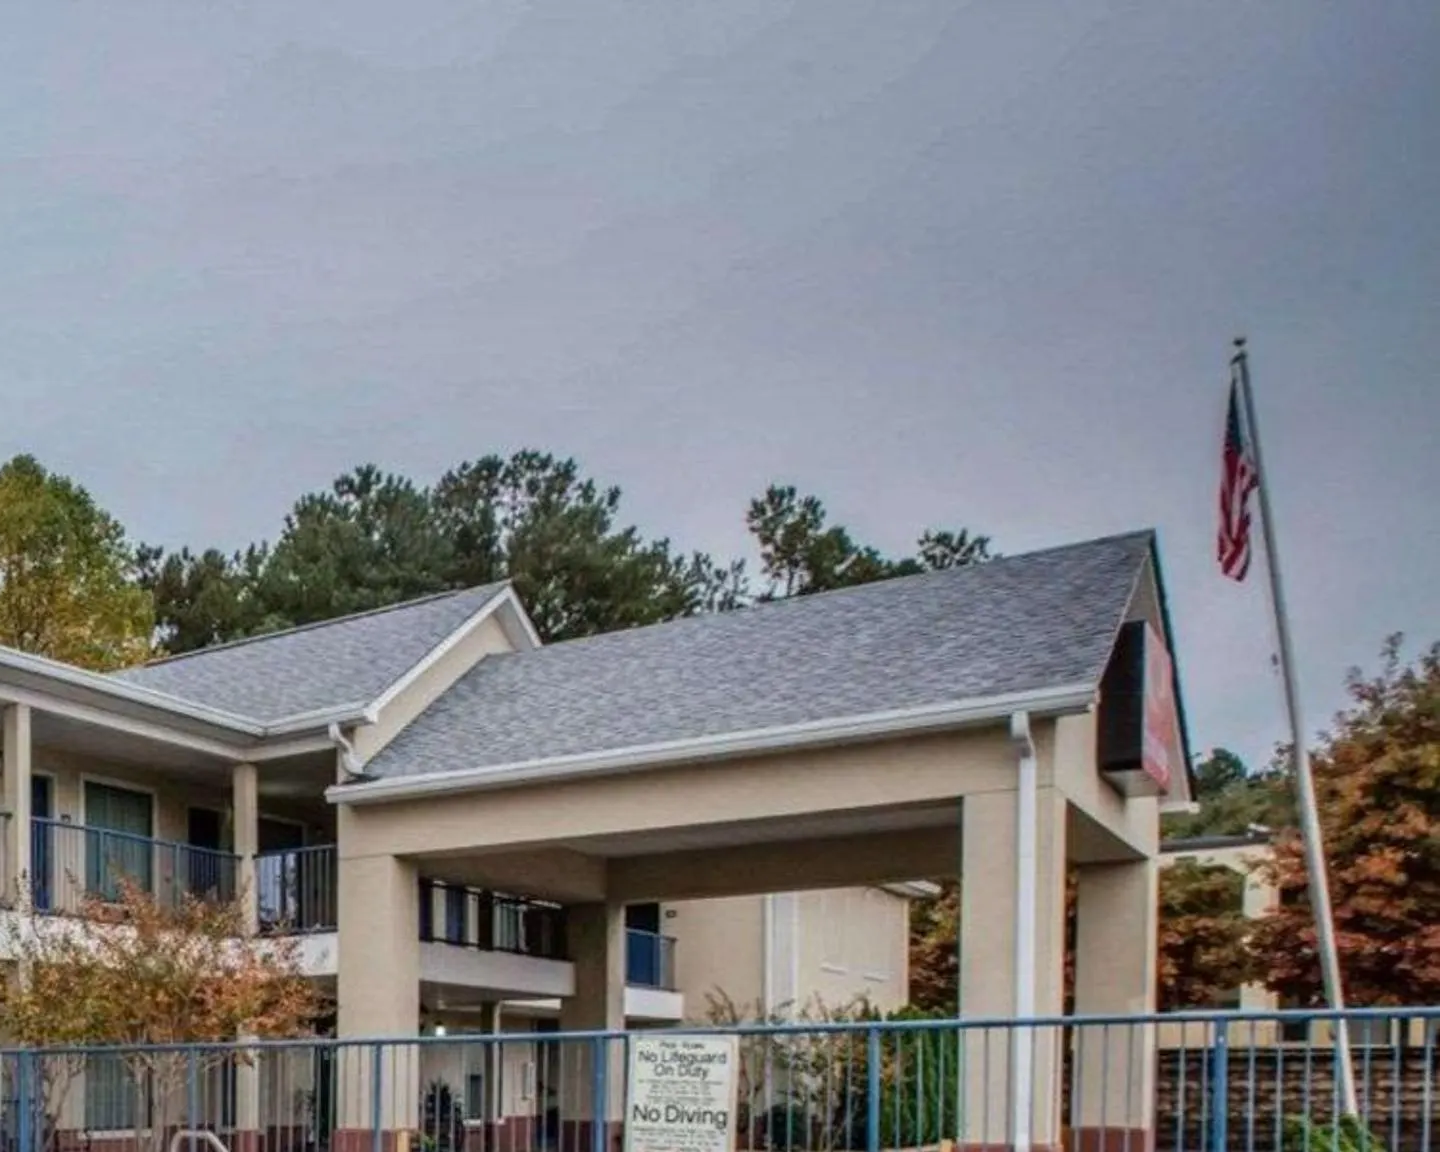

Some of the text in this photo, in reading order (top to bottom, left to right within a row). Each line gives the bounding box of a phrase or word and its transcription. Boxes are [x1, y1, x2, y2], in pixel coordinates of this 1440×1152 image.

[638, 1051, 727, 1067] No Lifeguard
[654, 1065, 709, 1080] On Duty
[632, 1104, 728, 1129] No Diving
